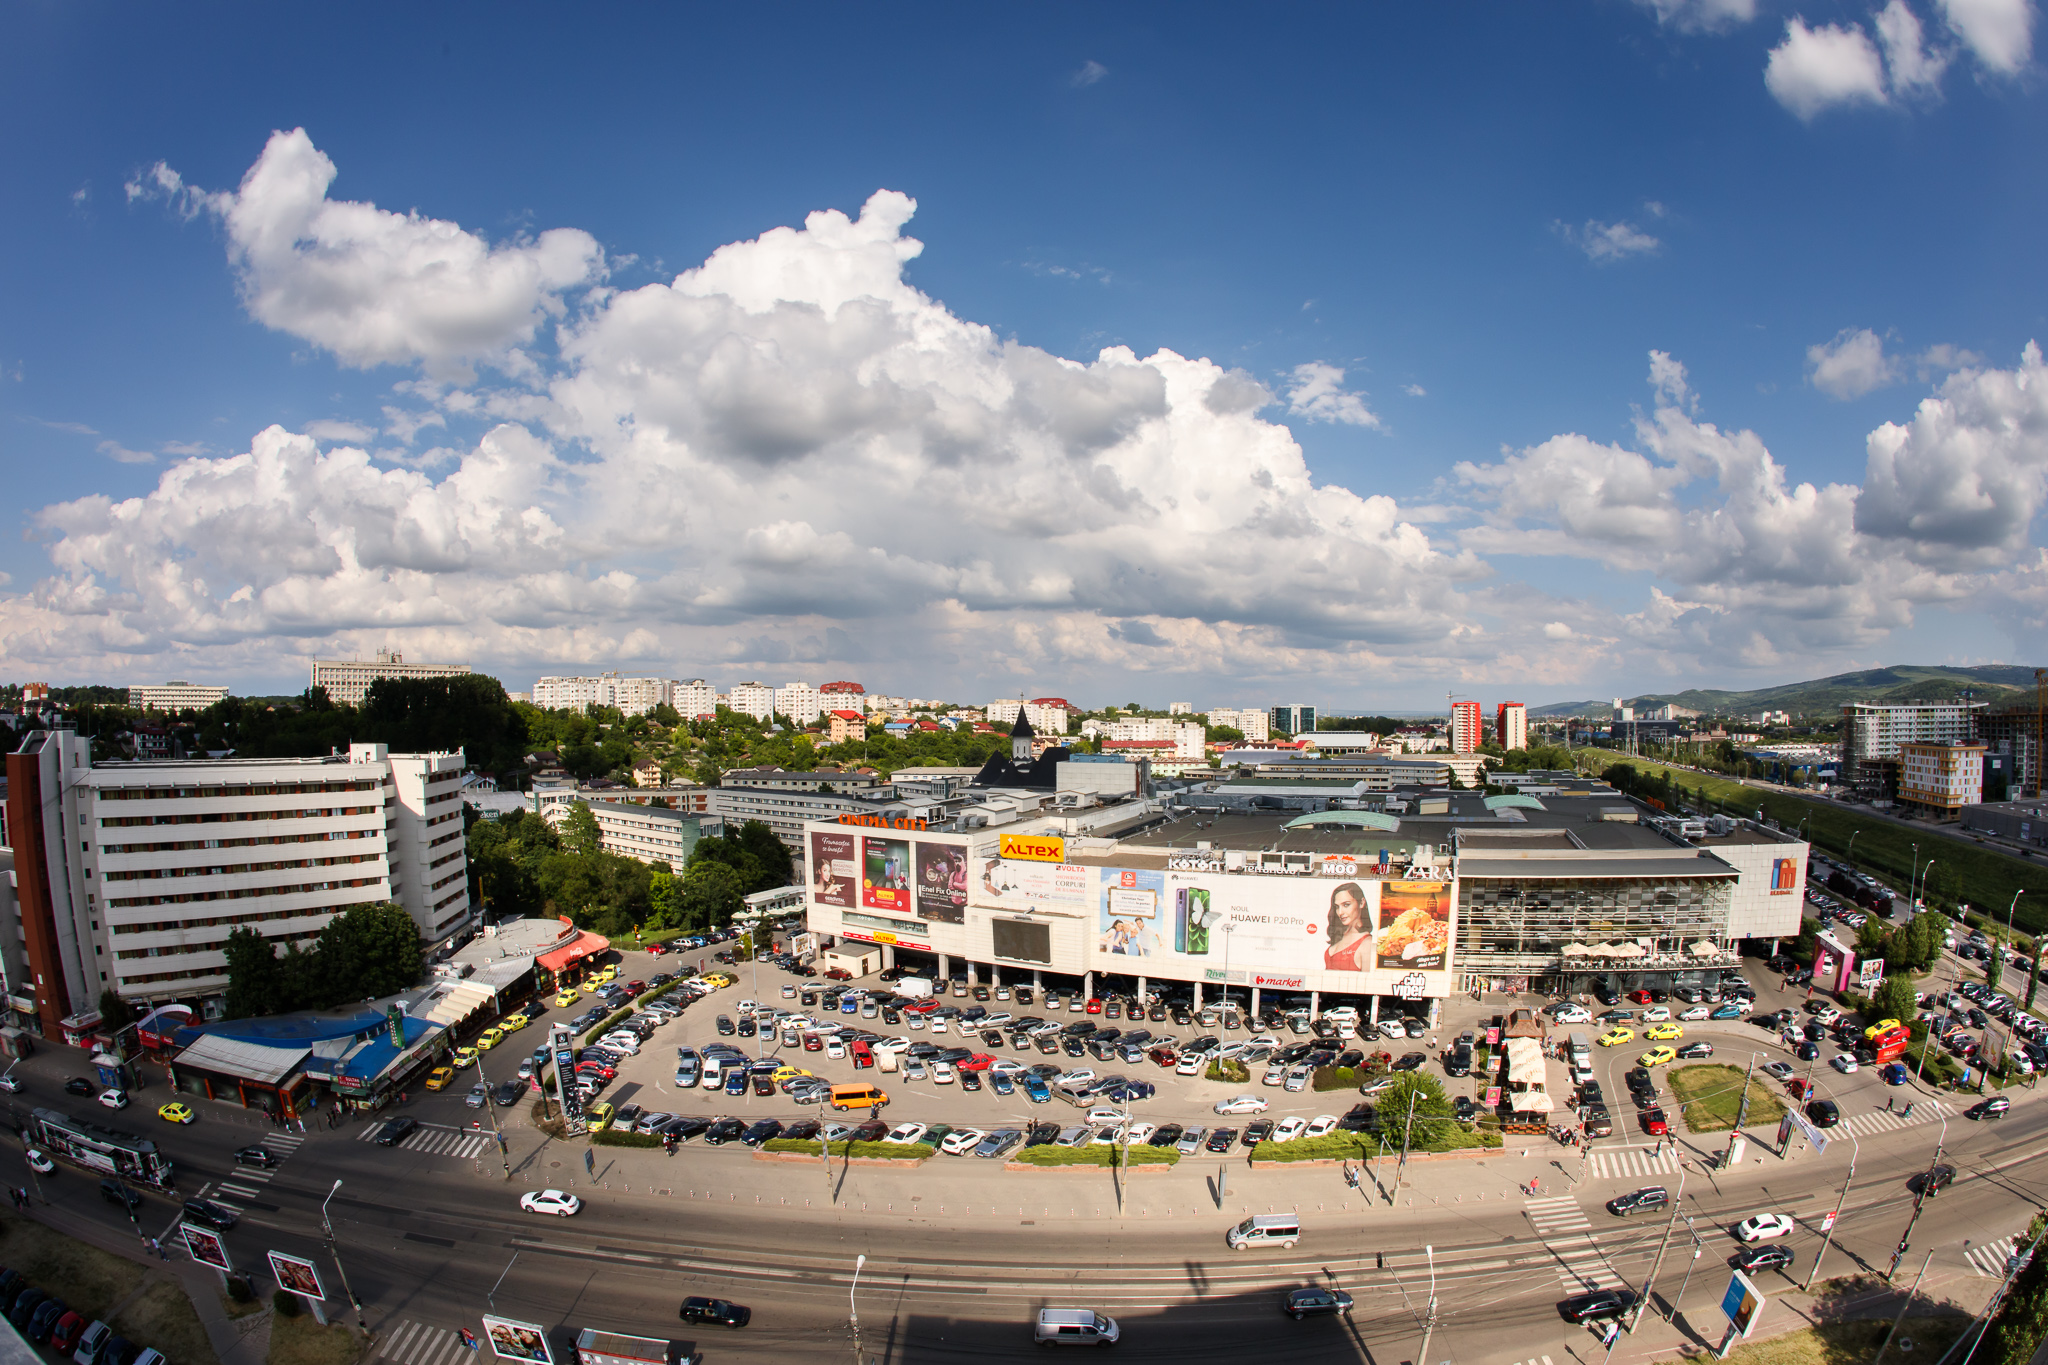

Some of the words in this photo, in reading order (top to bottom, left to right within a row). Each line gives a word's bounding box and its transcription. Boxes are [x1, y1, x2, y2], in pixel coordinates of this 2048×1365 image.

[838, 813, 889, 829] CINEMA
[894, 817, 928, 831] CITY
[1061, 865, 1085, 873] VOLTA
[1322, 863, 1357, 875] MOO
[1403, 865, 1454, 880] ZARA
[1055, 880, 1086, 888] CORPURI
[921, 885, 935, 893] Enel
[946, 888, 967, 897] Online
[1230, 914, 1271, 923] HUAWEI
[1273, 916, 1289, 925] P20
[1290, 917, 1304, 925] Pro
[1266, 978, 1302, 988] market
[1403, 972, 1426, 986] club
[1392, 984, 1425, 1000] viper
